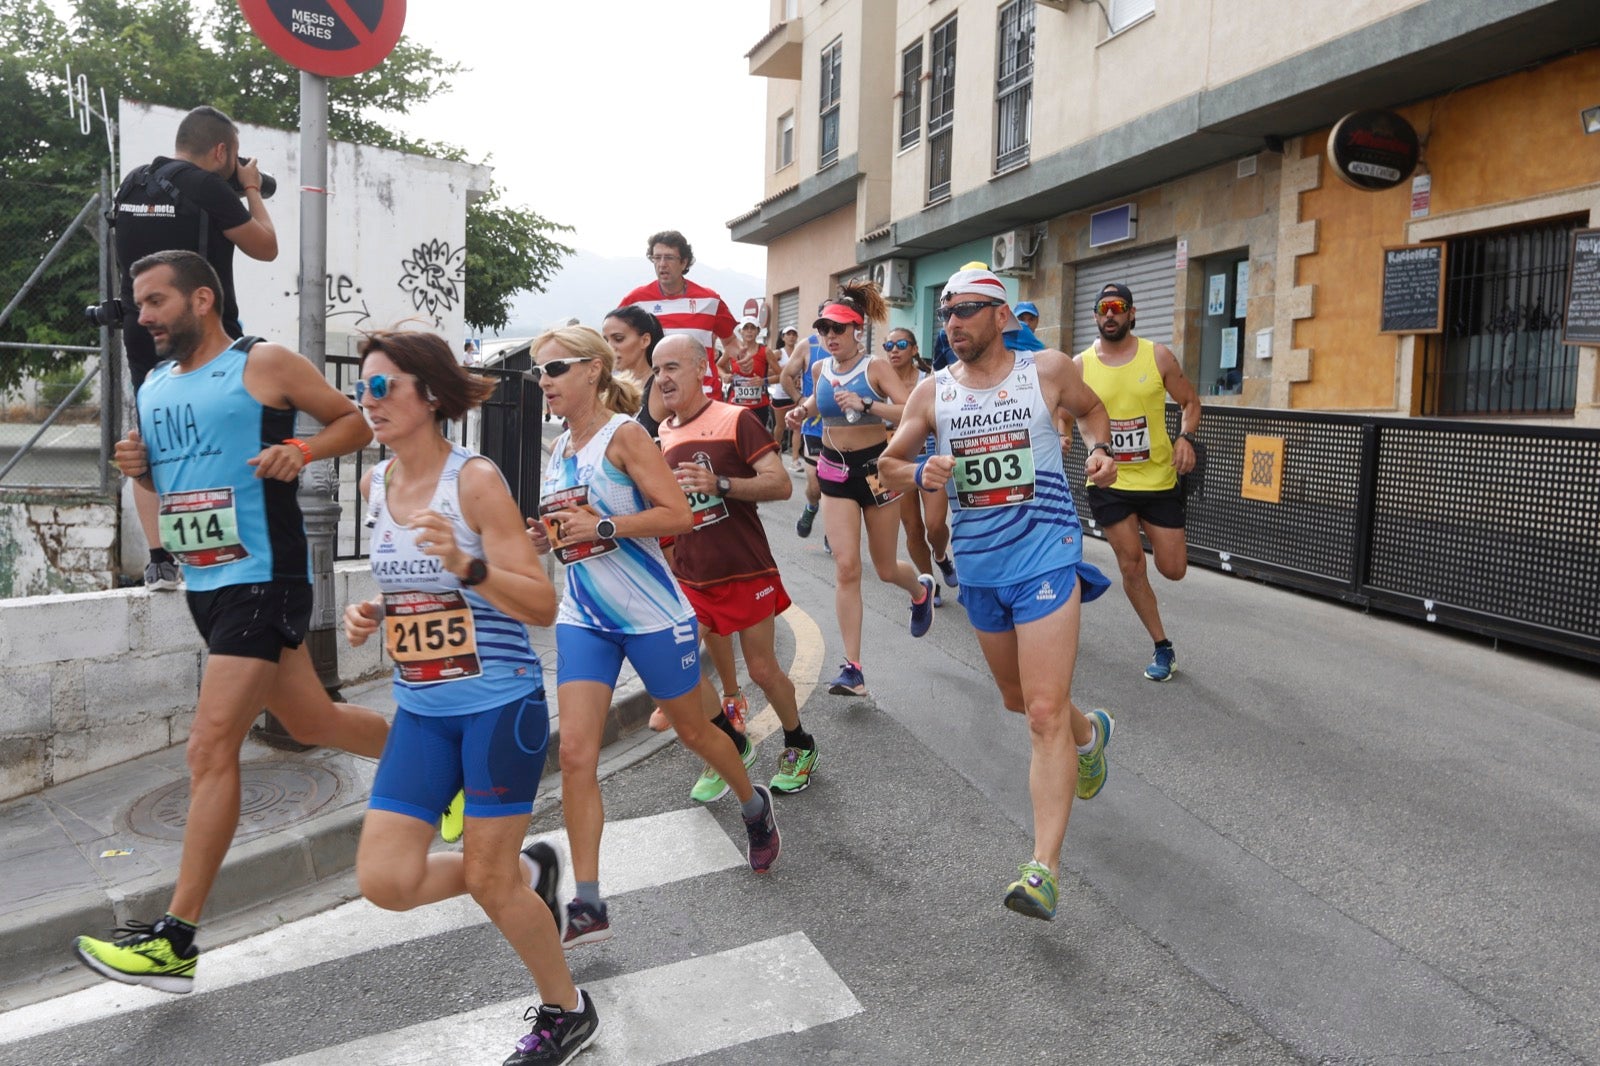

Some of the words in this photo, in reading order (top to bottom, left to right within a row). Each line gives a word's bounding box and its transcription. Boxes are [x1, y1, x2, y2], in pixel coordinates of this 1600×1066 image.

[292, 9, 335, 27] MESES
[292, 22, 332, 40] PARES
[738, 387, 760, 397] 3037
[153, 403, 200, 452] ENA
[950, 407, 1032, 431] MARACENA
[964, 437, 979, 448] GRAN
[980, 434, 1000, 446] PREMIO
[1000, 433, 1008, 443] DE
[1008, 431, 1026, 442] FONDO
[965, 453, 1022, 486] 503
[173, 513, 224, 545] 114
[394, 615, 467, 652] 2155
